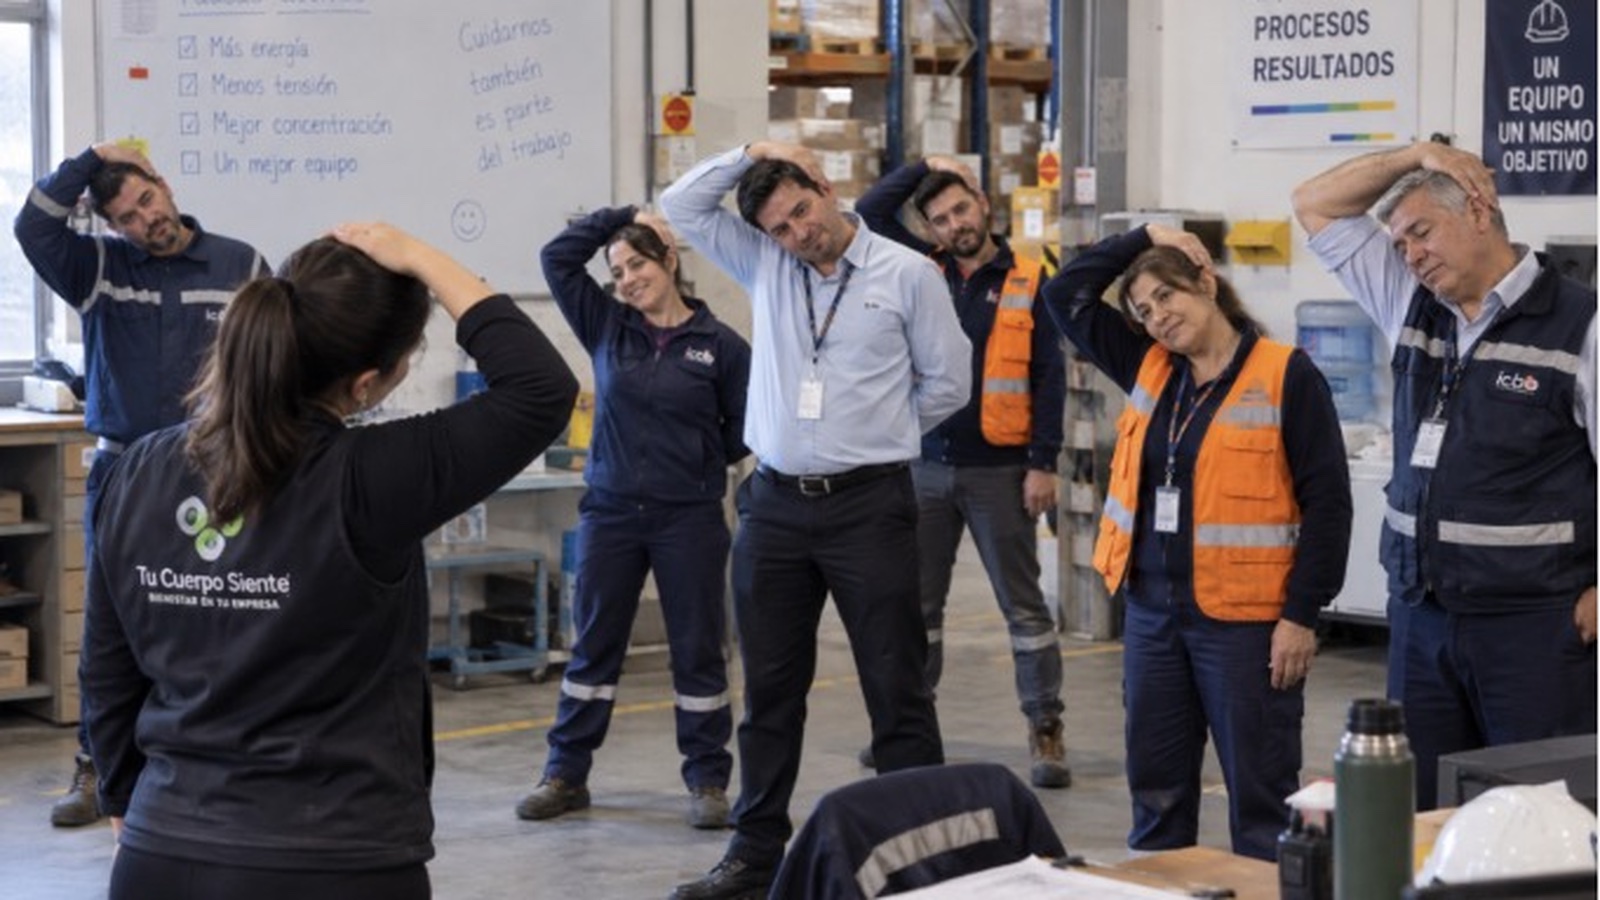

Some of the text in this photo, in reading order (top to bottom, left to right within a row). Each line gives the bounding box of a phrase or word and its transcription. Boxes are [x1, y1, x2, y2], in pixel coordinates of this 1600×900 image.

[459, 18, 553, 51] Cuidarnos
[1254, 10, 1370, 40] PROCESOS
[210, 36, 309, 67] Más energía
[1253, 51, 1395, 82] RESULTADOS
[470, 57, 543, 95] también
[1533, 56, 1560, 79] UN
[211, 72, 337, 96] Menos tensión
[1508, 85, 1584, 113] EQUIPO
[213, 112, 392, 143] Mejor concentración
[475, 95, 554, 131] es parte
[1499, 119, 1594, 143] UN MISMO
[477, 130, 573, 171] del trabajo
[1502, 150, 1588, 172] OBJETIVO
[214, 152, 358, 183] Un mejor equipo
[135, 565, 290, 595] Tu Cuerpo Siente
